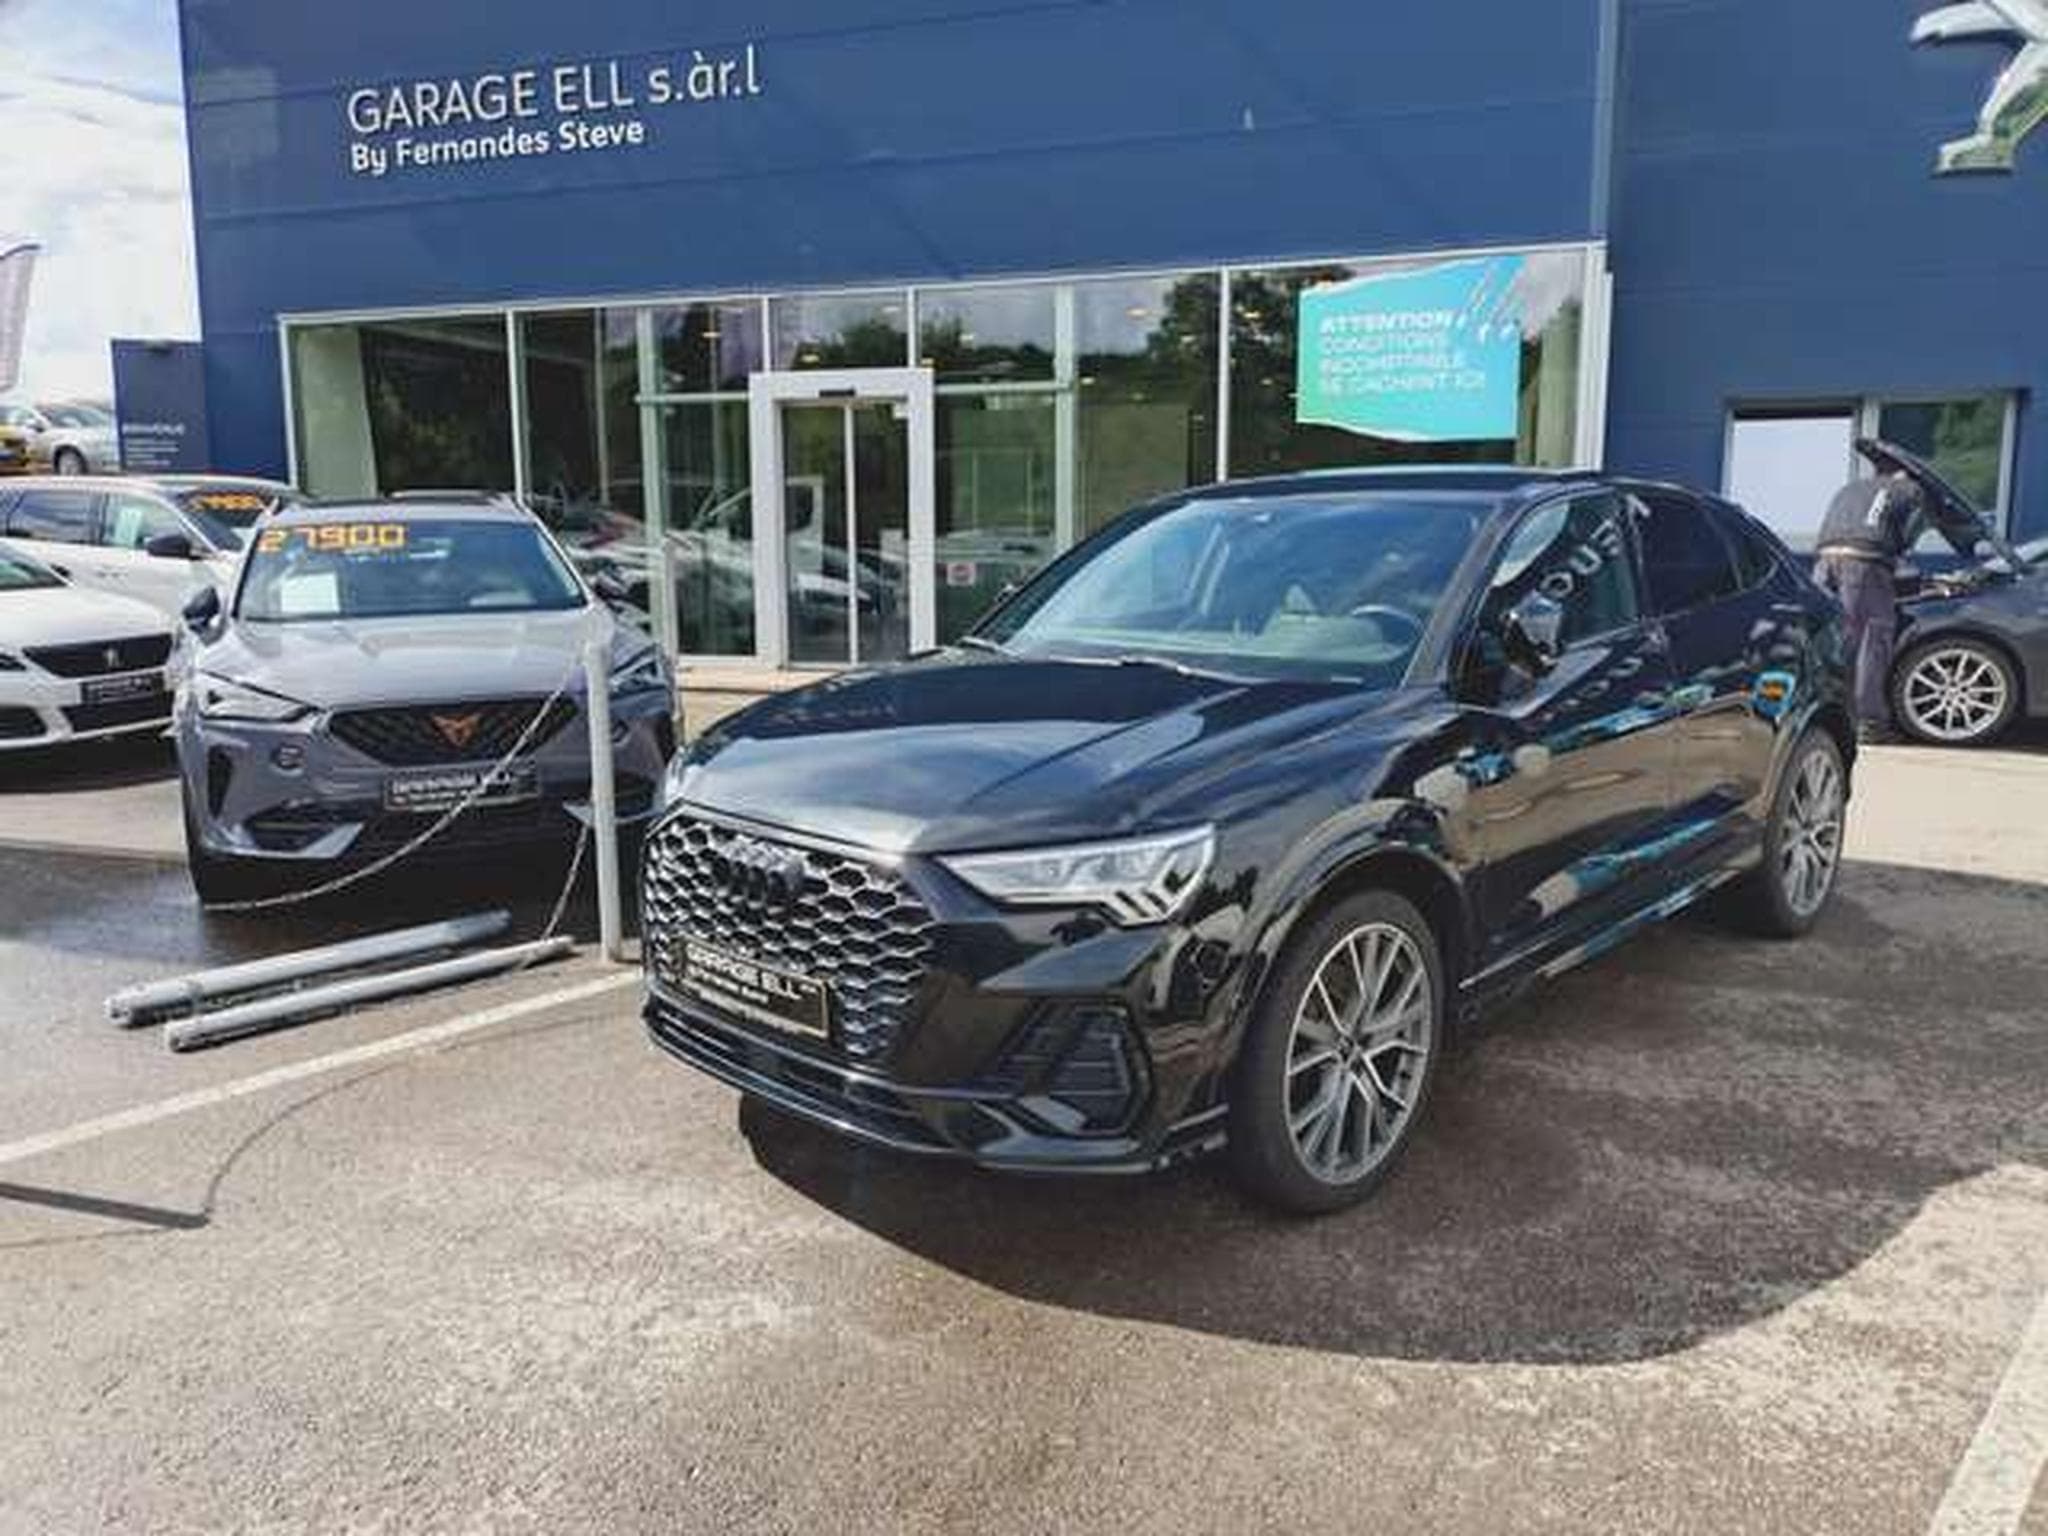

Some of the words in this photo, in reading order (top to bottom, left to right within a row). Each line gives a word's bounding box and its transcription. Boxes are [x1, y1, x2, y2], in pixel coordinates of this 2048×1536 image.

[347, 69, 539, 133] GARAGE
[553, 60, 634, 113] ELL
[648, 44, 761, 103] s.àr.l
[351, 143, 388, 175] By
[397, 127, 551, 167] Fernandes
[559, 118, 645, 151] Steve
[257, 523, 405, 553] 27900
